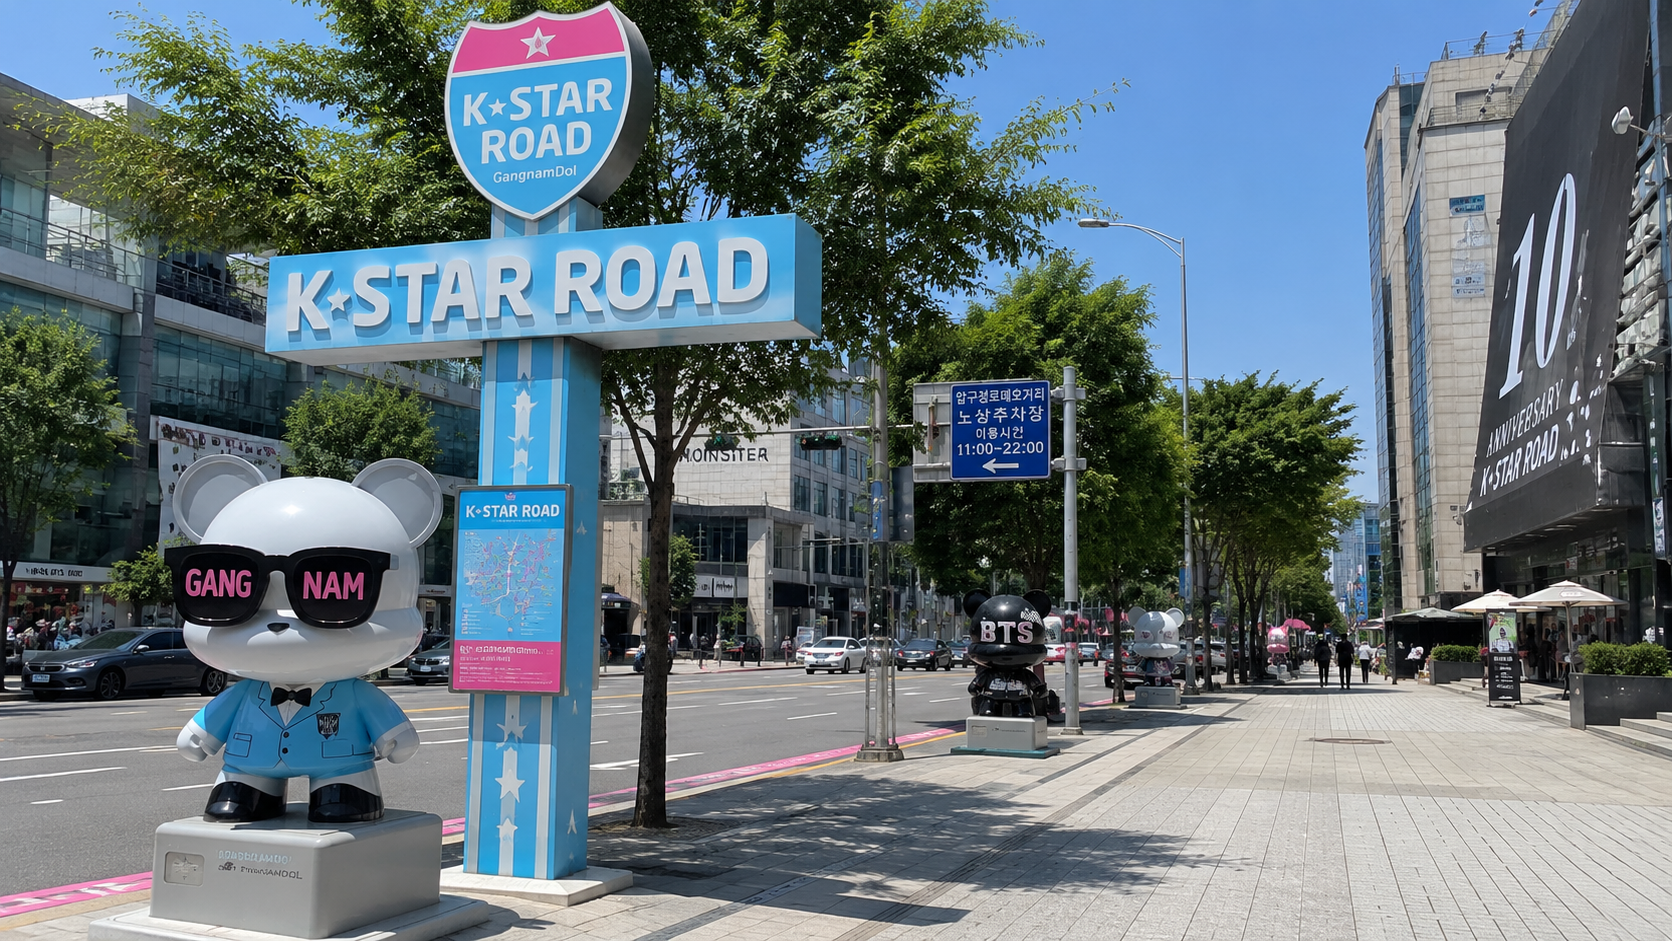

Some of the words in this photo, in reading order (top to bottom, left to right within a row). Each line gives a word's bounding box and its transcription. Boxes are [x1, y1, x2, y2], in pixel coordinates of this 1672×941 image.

[481, 121, 592, 164] ROAD
[493, 165, 577, 184] GangnamDol
[554, 237, 769, 314] ROAD
[1499, 173, 1576, 399] 10
[1522, 423, 1559, 476] ROAD
[522, 504, 560, 518] ROAD
[185, 568, 252, 598] GANG
[303, 571, 365, 600] NAM
[980, 621, 1033, 643] BTS
